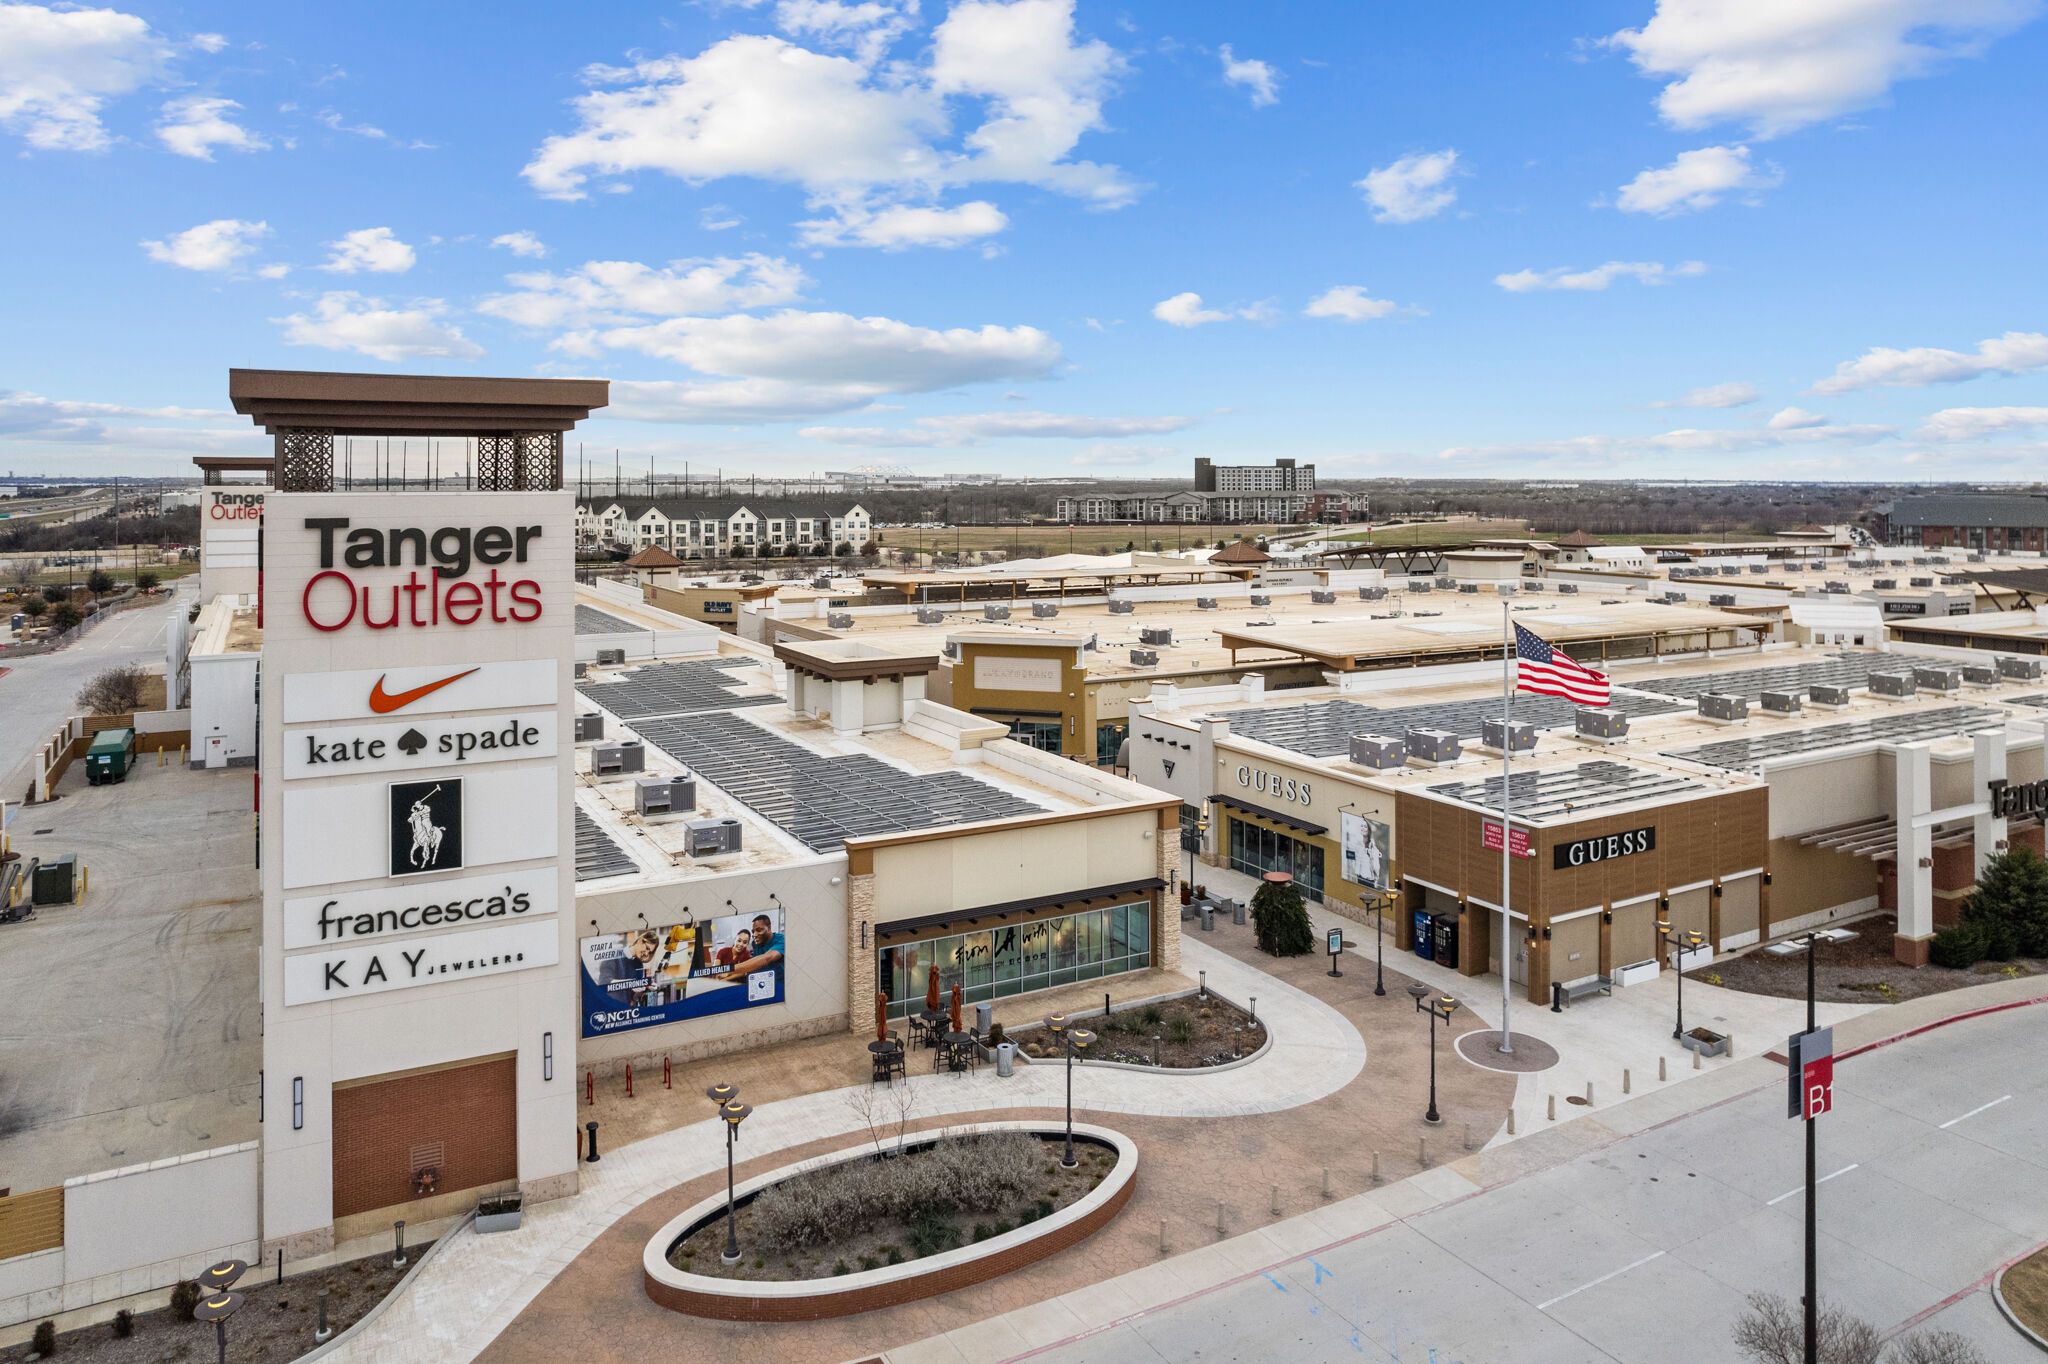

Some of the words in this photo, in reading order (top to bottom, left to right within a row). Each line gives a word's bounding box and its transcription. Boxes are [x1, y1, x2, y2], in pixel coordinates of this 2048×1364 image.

[305, 517, 542, 579] Tanger
[303, 568, 543, 632] Outlets
[306, 734, 386, 765] kate
[438, 720, 540, 761] spade
[1236, 764, 1311, 806] GUESS
[1568, 830, 1648, 866] GUESS
[318, 886, 530, 941] francesca's
[590, 942, 608, 952] START
[608, 942, 613, 950] A
[594, 952, 615, 961] CAREER
[955, 944, 988, 965] From
[994, 926, 1016, 958] LA
[1022, 923, 1048, 944] with
[325, 949, 426, 990] KAY
[428, 952, 524, 976] JEWELERS
[607, 979, 648, 992] MECHATRONICS
[694, 968, 711, 977] ALLIED
[711, 965, 730, 974] HEALTH
[607, 1008, 640, 1022] NCTC
[1810, 1080, 1834, 1118] B1
